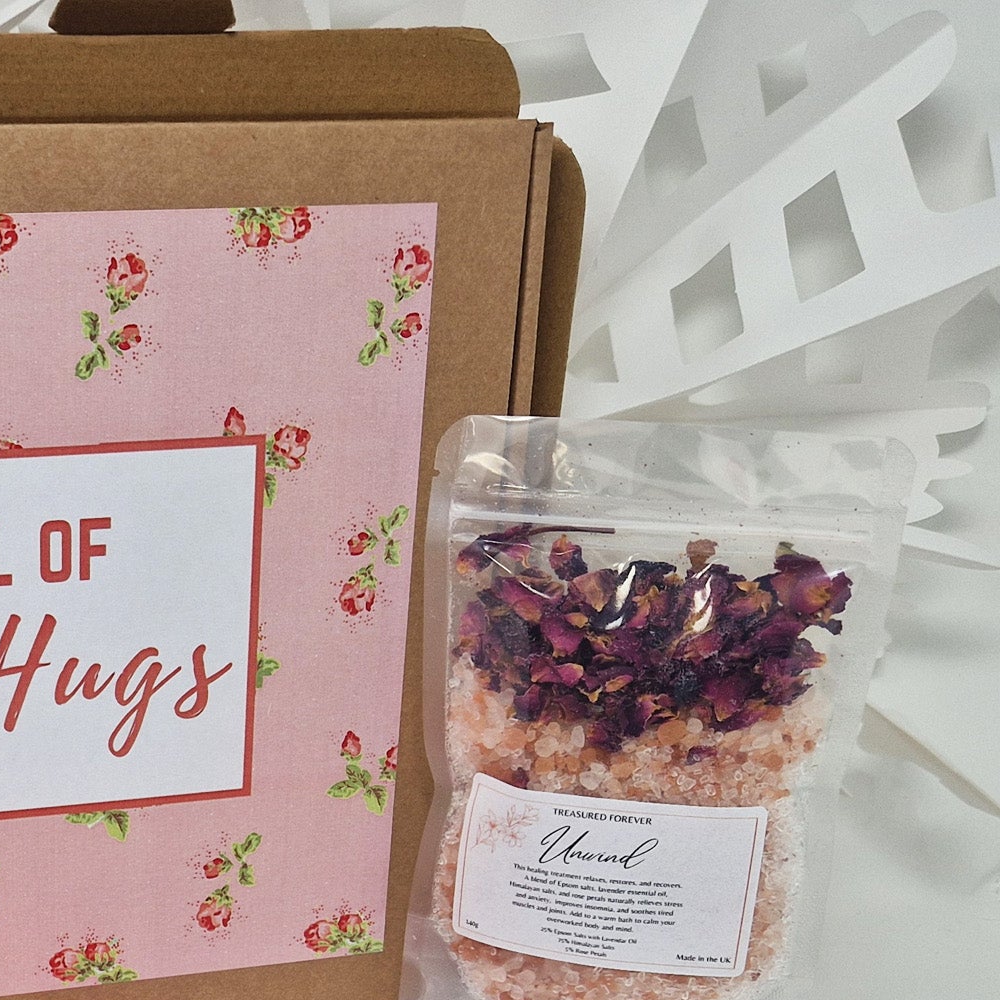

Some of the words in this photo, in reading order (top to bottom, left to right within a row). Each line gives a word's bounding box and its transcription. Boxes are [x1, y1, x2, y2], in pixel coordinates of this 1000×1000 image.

[40, 516, 112, 583] OF
[553, 808, 607, 821] TREASURED
[609, 814, 652, 825] FOREVER
[539, 825, 659, 869] Unwind
[527, 866, 548, 876] healing
[551, 871, 581, 880] treatment
[509, 881, 540, 892] Himalayan
[530, 876, 548, 884] blend
[557, 881, 579, 889] Epsom
[598, 886, 626, 895] lavender
[512, 901, 535, 909] muscles
[555, 899, 583, 908] improves
[547, 917, 583, 927] overworked
